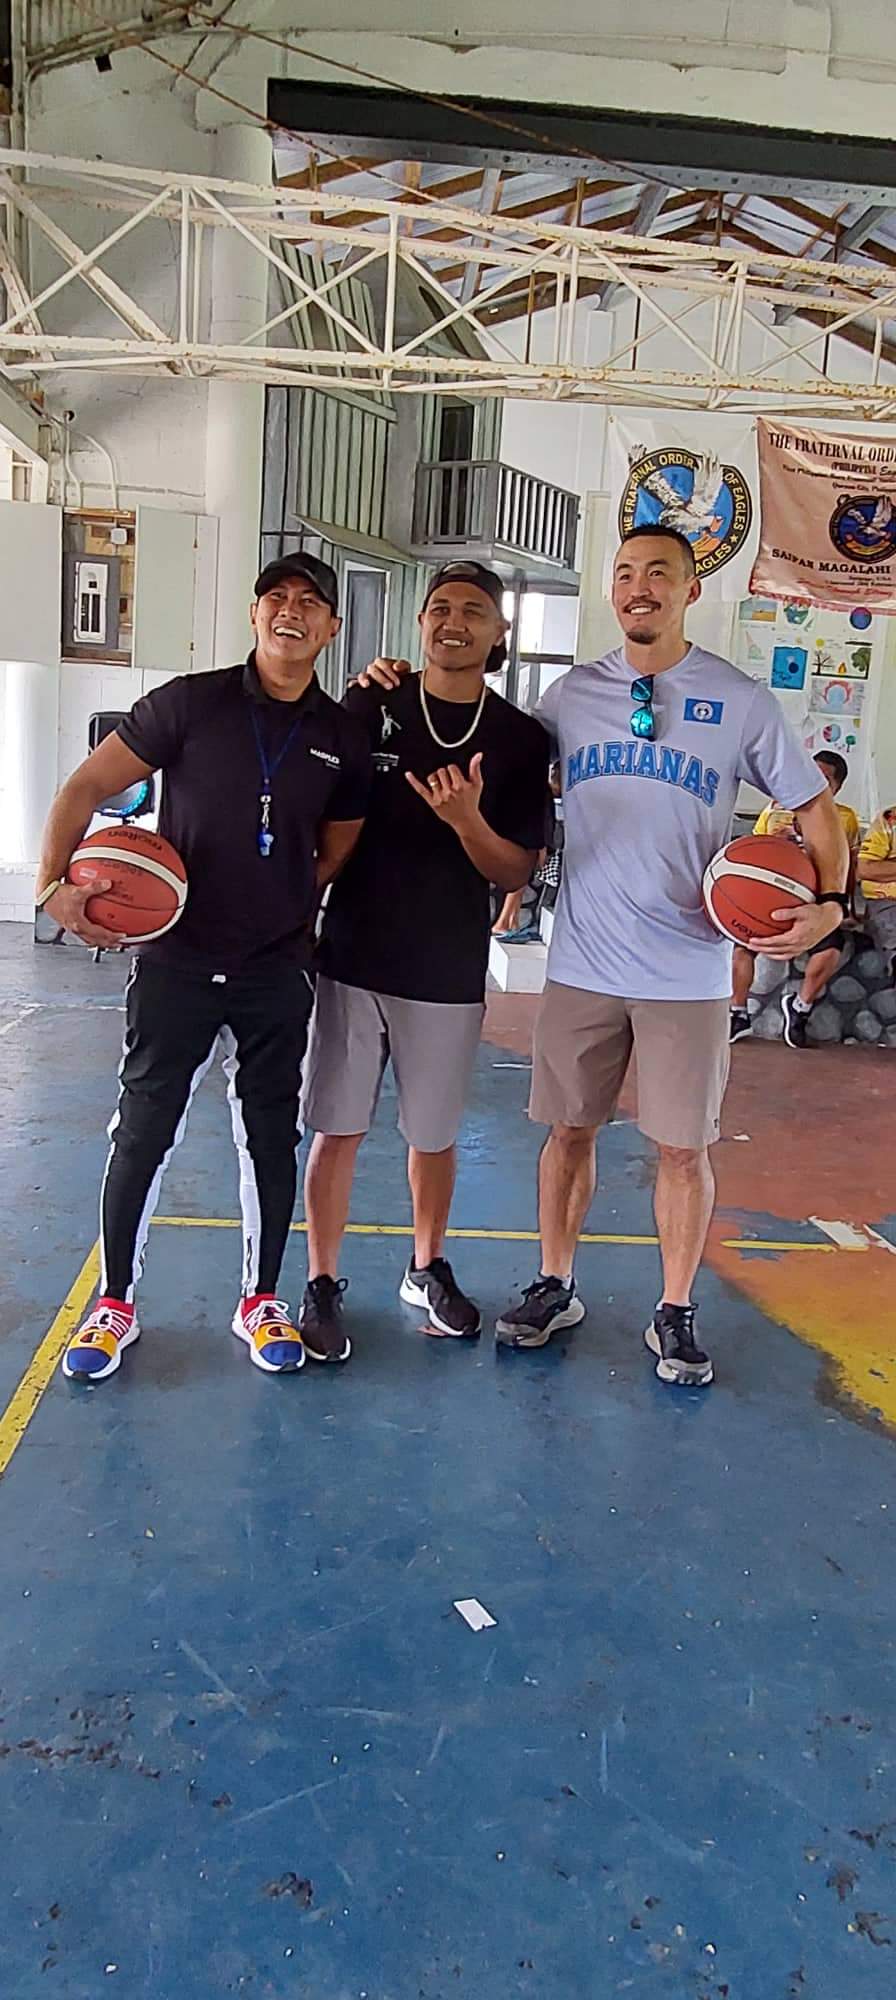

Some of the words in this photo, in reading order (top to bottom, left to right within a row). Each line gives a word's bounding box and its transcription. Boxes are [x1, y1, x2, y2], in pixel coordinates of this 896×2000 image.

[768, 433, 792, 450] THE
[795, 438, 865, 460] FRATERNAL
[624, 460, 657, 513] FRATERNAL
[724, 472, 739, 485] OF
[733, 487, 747, 530] EAGLES
[695, 543, 732, 575] AGLES
[818, 562, 891, 574] MAGALAHI
[566, 740, 721, 808] MARIANAS
